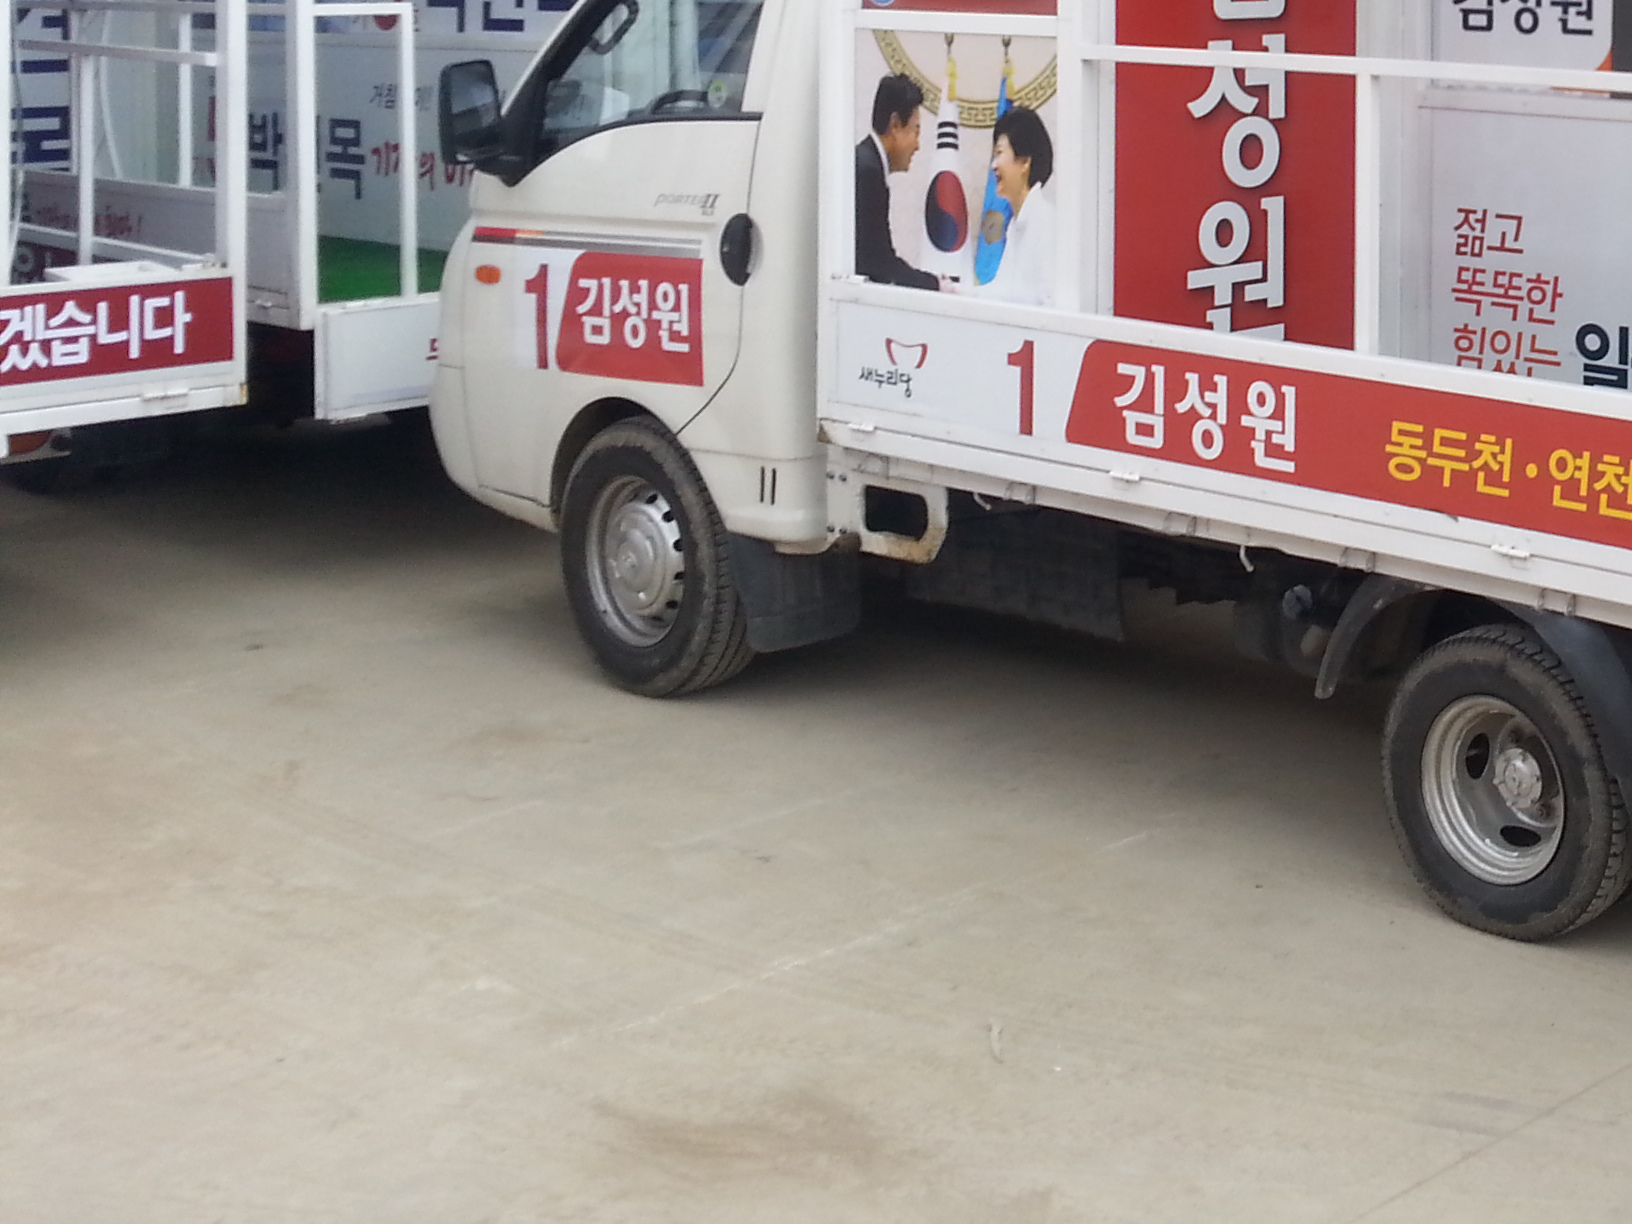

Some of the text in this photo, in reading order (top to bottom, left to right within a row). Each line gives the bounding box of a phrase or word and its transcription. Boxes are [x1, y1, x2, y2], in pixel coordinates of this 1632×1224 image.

[1454, 208, 1524, 258] 젊고
[525, 264, 690, 369] 1 김성원
[1451, 266, 1563, 325] 똑똑한
[859, 367, 912, 398] 새누리당
[1007, 340, 1034, 436] 1
[1114, 362, 1296, 473] 김성원
